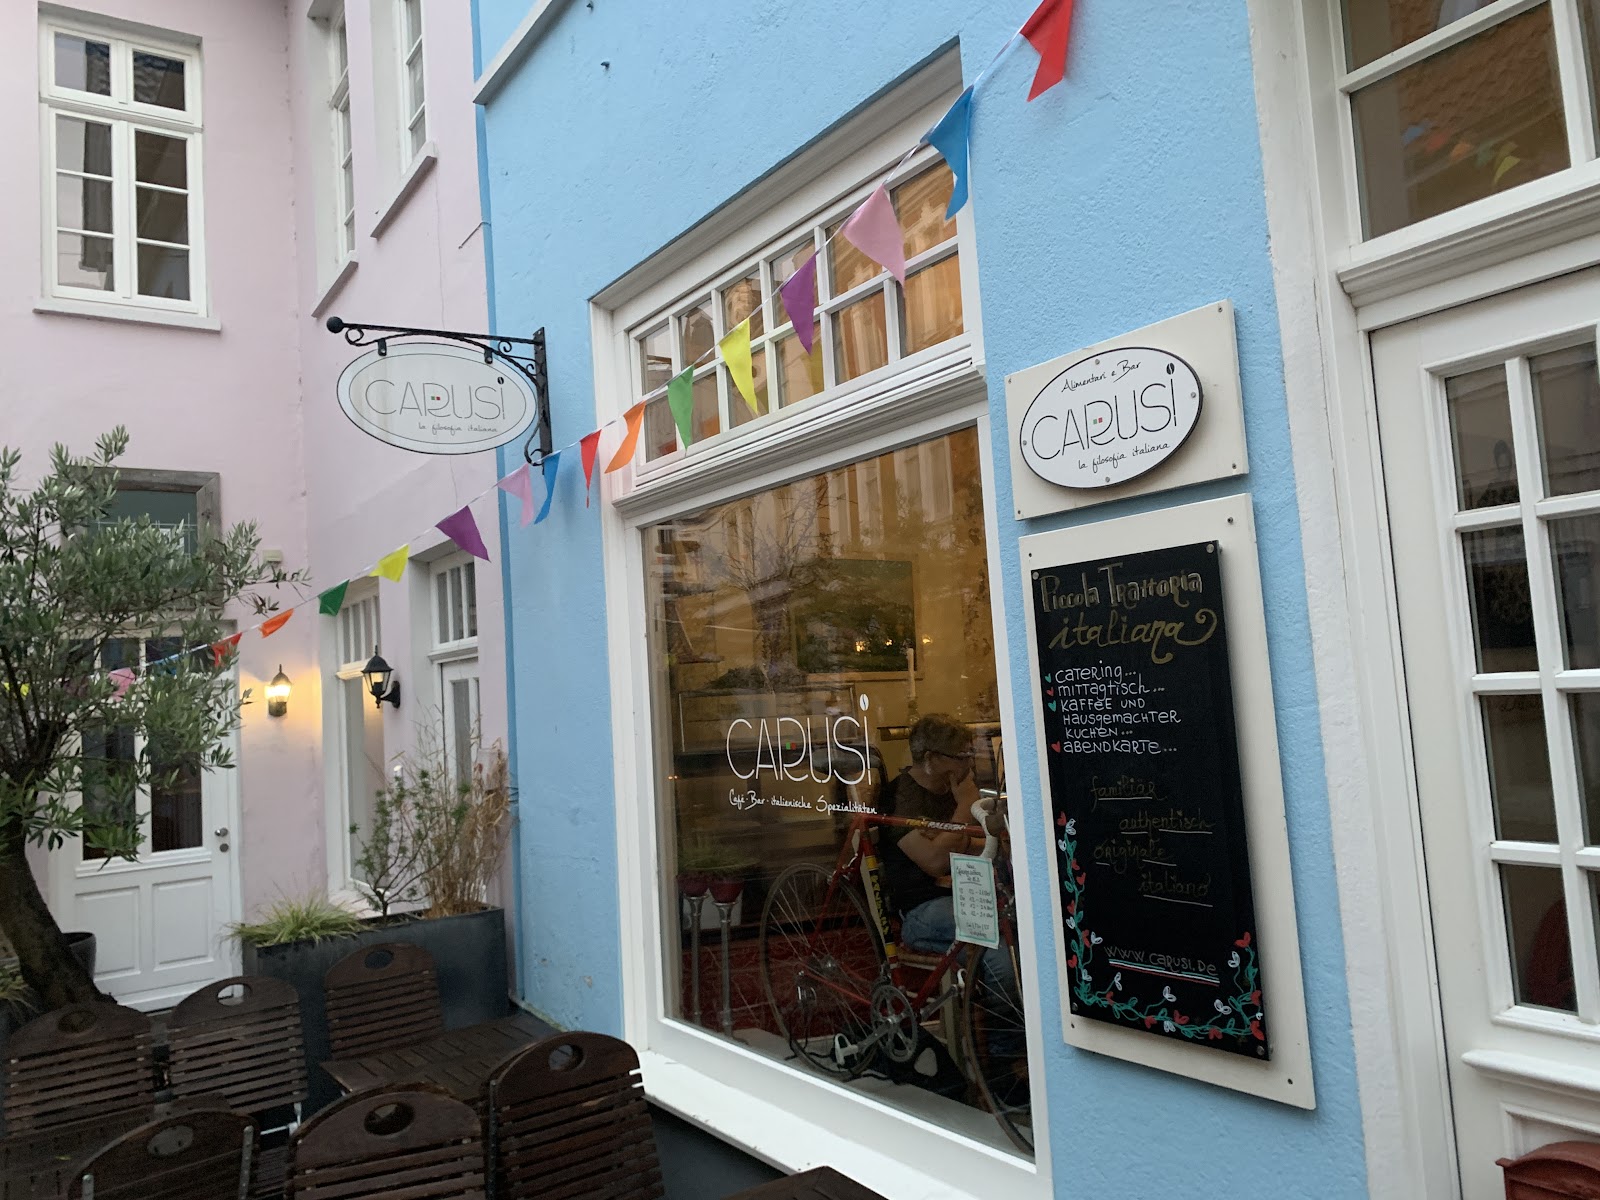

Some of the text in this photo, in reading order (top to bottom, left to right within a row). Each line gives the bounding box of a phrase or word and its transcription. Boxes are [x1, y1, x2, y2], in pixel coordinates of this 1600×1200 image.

[1061, 371, 1107, 392] Alimentari
[1112, 359, 1142, 383] Bar
[418, 422, 498, 436] la filosofia italiana
[1078, 442, 1171, 473] la filosofia italiana
[1048, 608, 1218, 665] italiana
[816, 794, 878, 815] Spezialitäten
